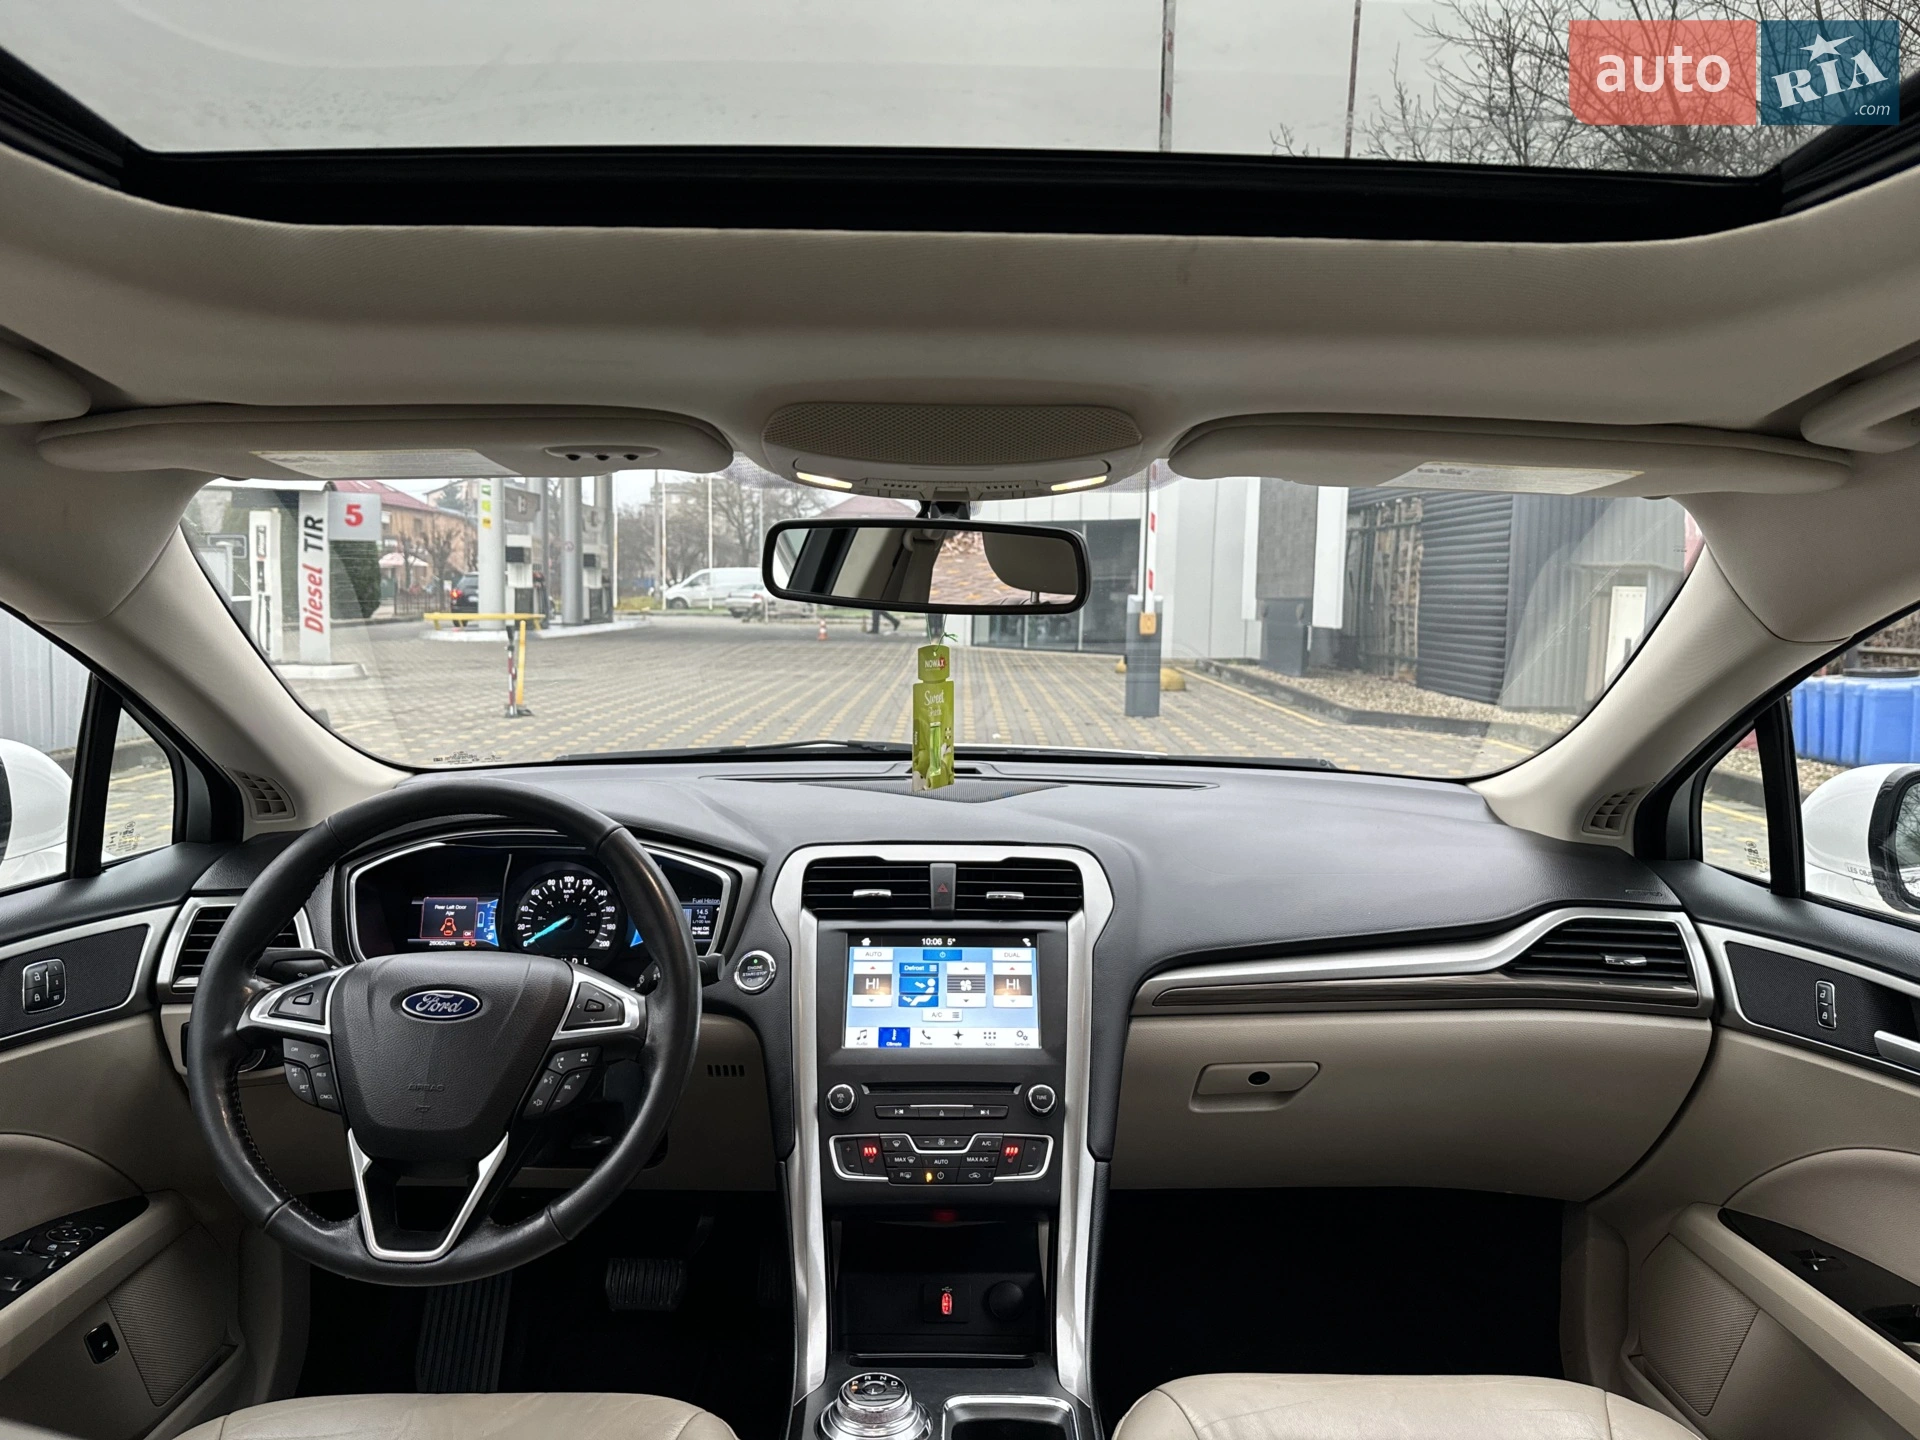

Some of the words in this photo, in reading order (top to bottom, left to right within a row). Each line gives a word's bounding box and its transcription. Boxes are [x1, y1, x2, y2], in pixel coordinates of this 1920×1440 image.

[344, 504, 363, 527] 5
[304, 515, 323, 552] TIR
[302, 564, 324, 634] Diesel
[925, 659, 944, 668] NOWAX
[924, 690, 944, 706] Sweet
[922, 938, 942, 946] 10:06
[865, 978, 879, 990] HI
[1006, 979, 1020, 990] HI
[416, 993, 464, 1013] Ford
